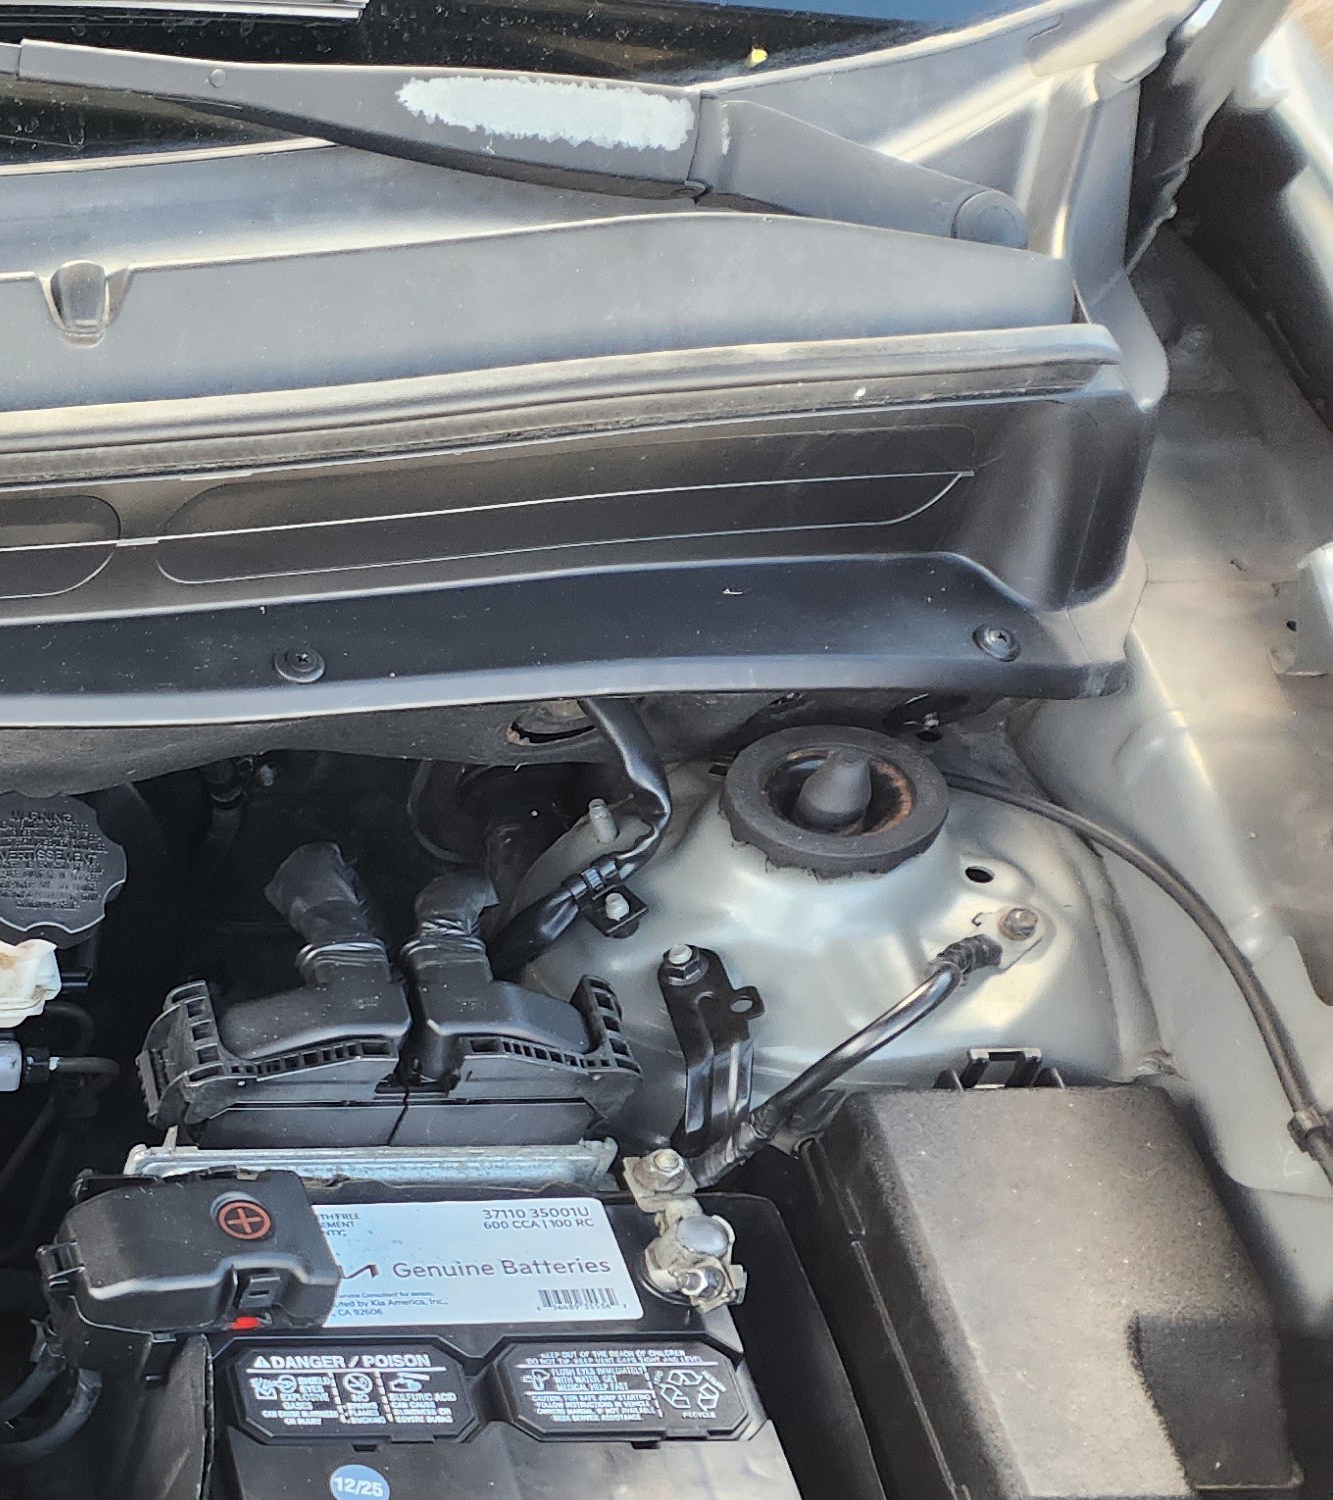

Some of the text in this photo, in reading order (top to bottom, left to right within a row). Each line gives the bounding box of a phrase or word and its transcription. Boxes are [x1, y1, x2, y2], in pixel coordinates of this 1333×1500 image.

[483, 1206, 589, 1219] 37110 35001U
[484, 1220, 509, 1229] 600
[513, 1220, 540, 1229] CCA
[550, 1219, 572, 1228] 100
[576, 1218, 594, 1227] RC
[393, 1261, 493, 1278] Genuine
[501, 1257, 612, 1275] Batteries
[270, 1355, 346, 1369] DANGER
[362, 1354, 431, 1368] POISON
[334, 1476, 384, 1497] 12/25
